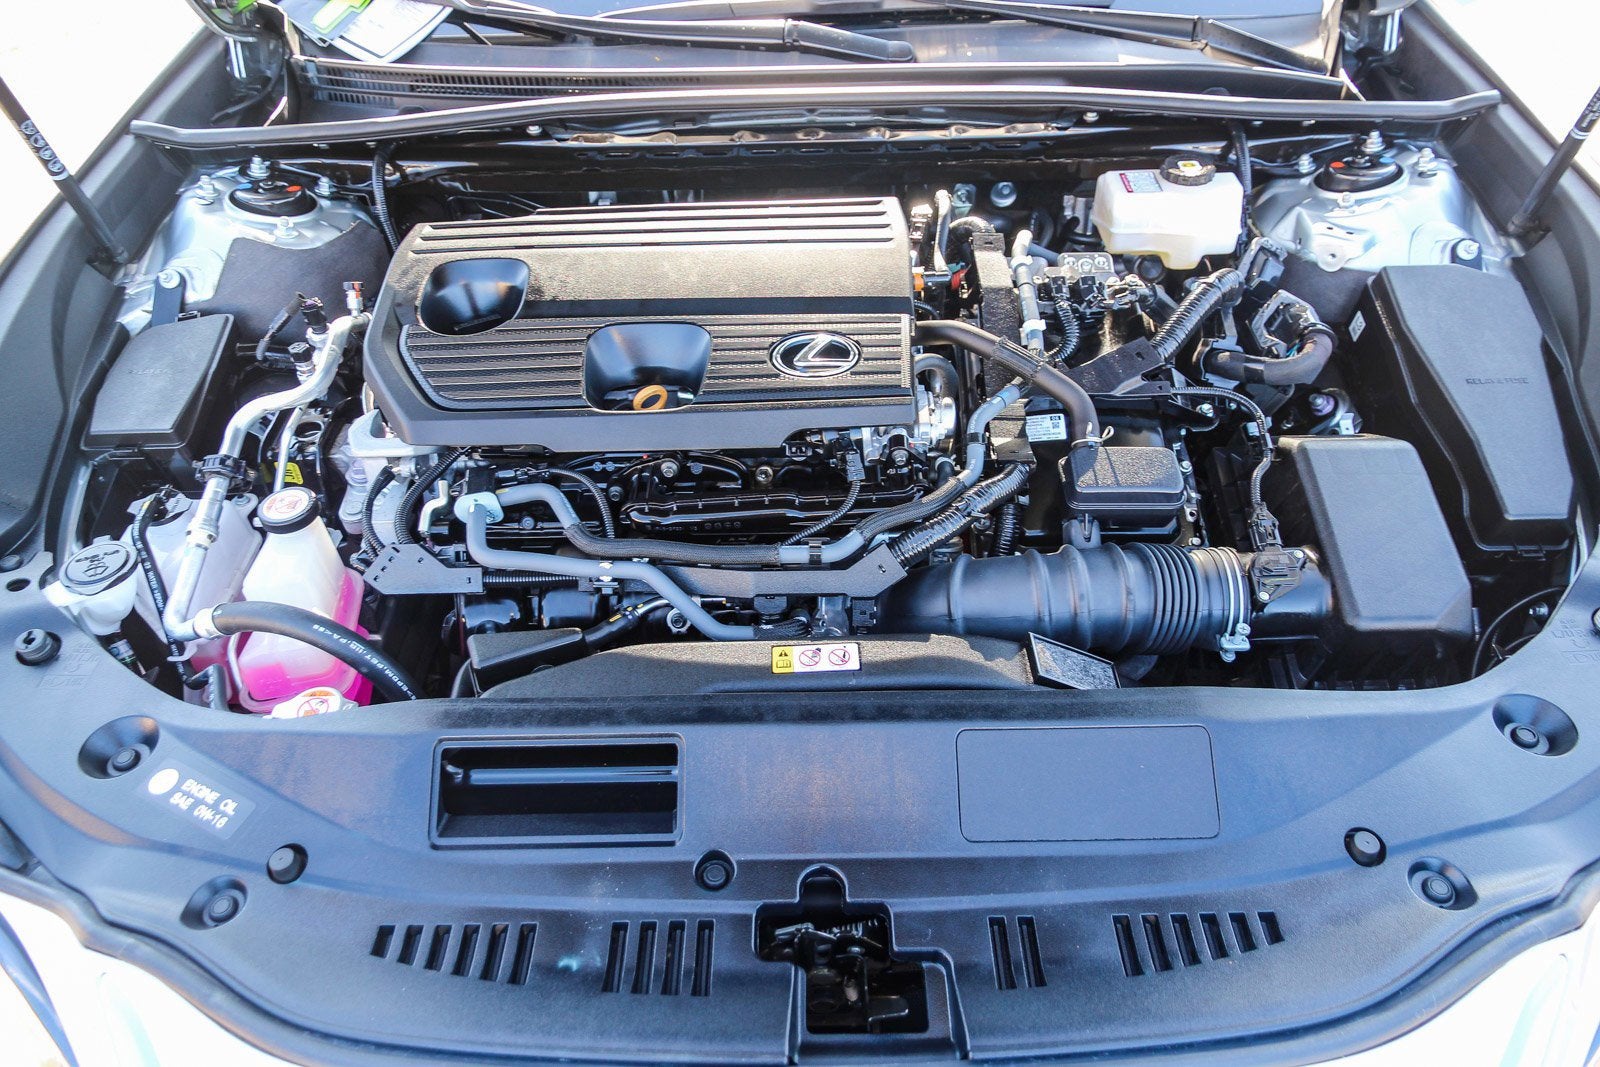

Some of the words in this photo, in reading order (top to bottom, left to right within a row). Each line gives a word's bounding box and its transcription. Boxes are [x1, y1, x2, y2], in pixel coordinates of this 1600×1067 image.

[169, 791, 195, 811] SAE
[180, 778, 221, 805] ENGINE
[219, 798, 239, 815] OIL
